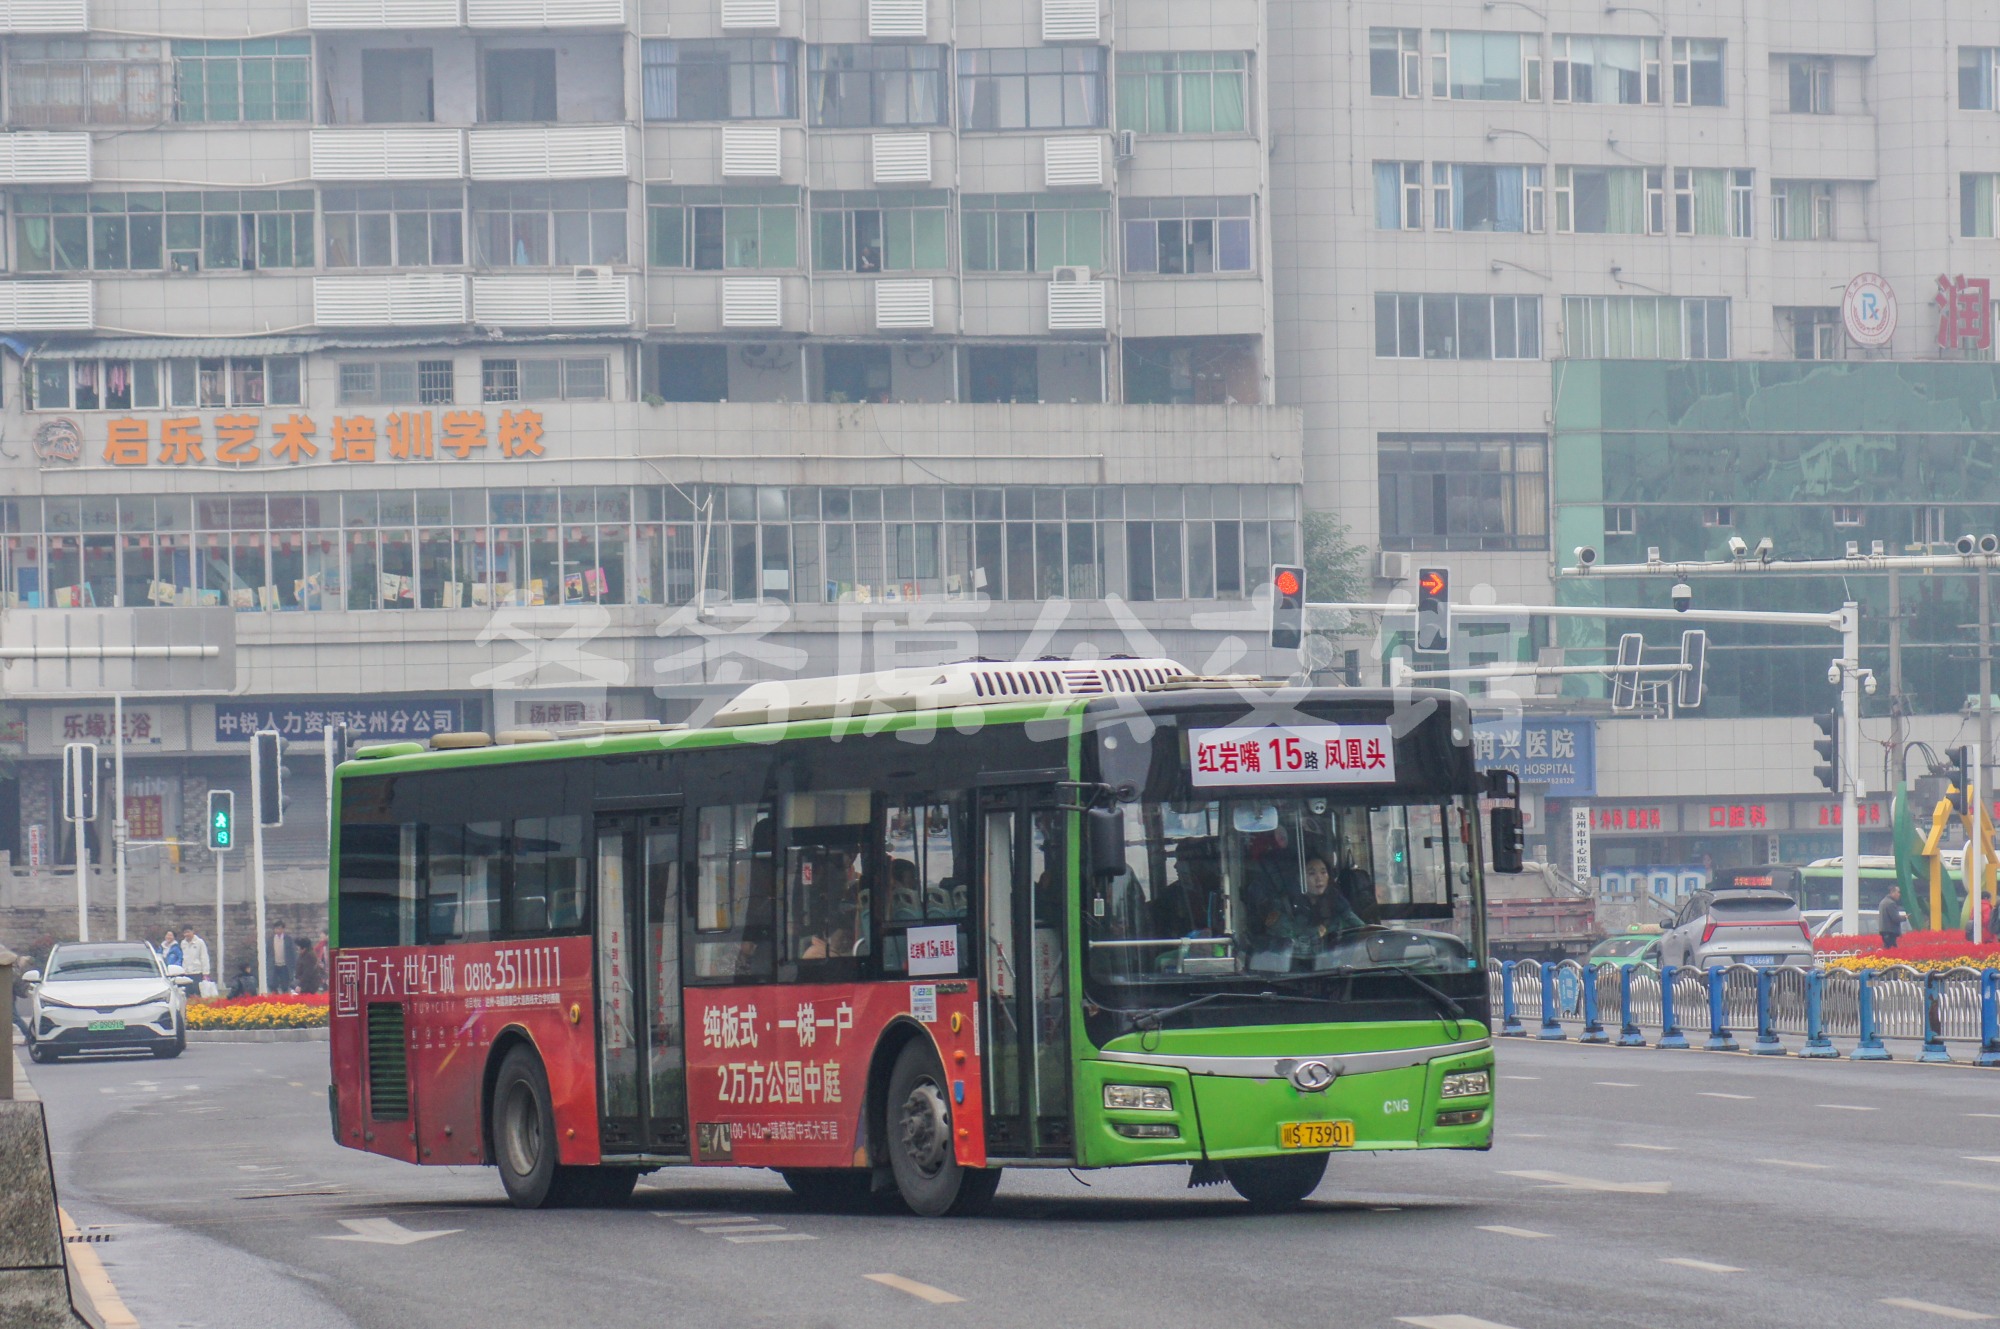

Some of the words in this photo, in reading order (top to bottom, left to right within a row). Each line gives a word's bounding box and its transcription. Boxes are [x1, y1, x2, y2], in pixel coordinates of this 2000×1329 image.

[1935, 273, 1991, 349] 润
[103, 408, 546, 466] 启乐艺术培训学校
[63, 713, 151, 739] 乐缘足浴
[219, 709, 453, 735] 中锐人力资源达州分公司
[1197, 740, 1261, 774] 红岩嘴
[1269, 737, 1319, 770] 15路
[1325, 737, 1387, 769] 凤凰头
[1473, 728, 1575, 760] 润兴医院
[1524, 763, 1576, 775] HOSPITAL
[1709, 804, 1767, 828] 口腔科
[1818, 803, 1880, 826] 血液析科
[464, 946, 561, 992] 0818-3511111
[703, 1002, 853, 1048] 纯板式·一梯一户
[718, 1059, 841, 1104] 2万方公园中庭
[1383, 1098, 1410, 1114] CNG
